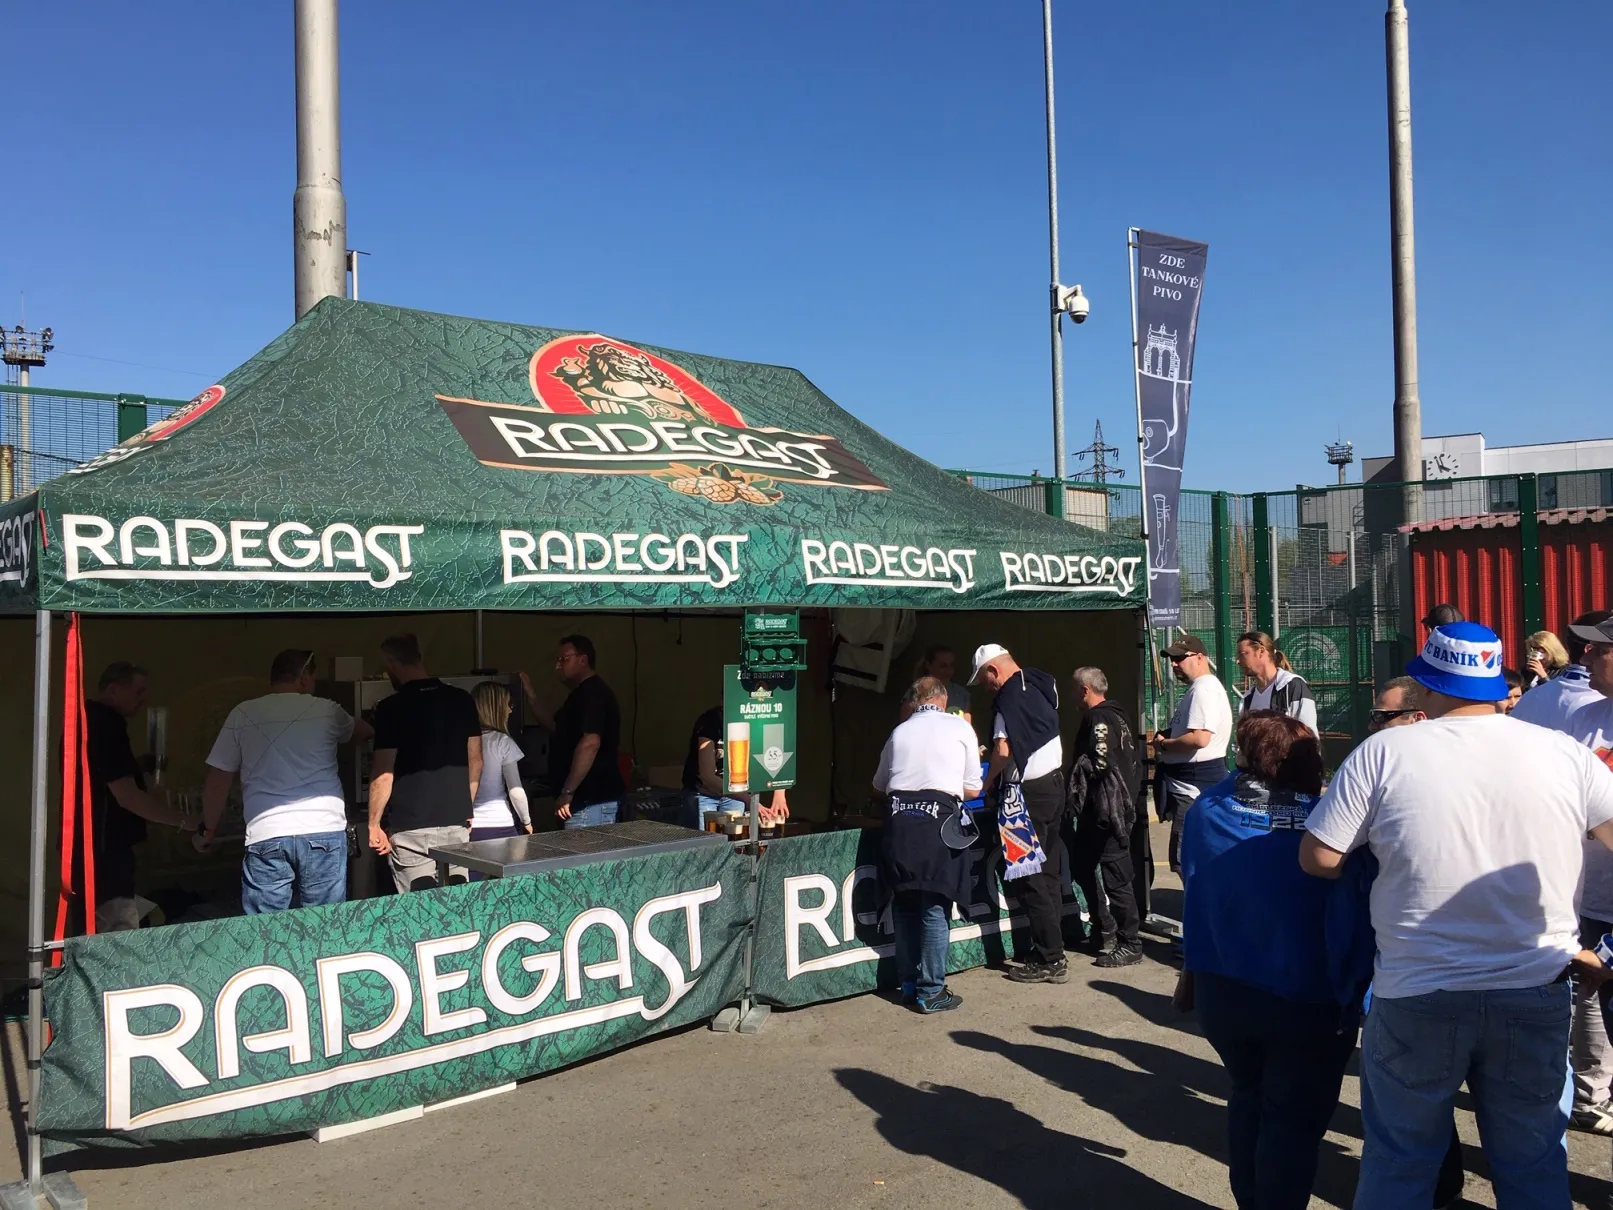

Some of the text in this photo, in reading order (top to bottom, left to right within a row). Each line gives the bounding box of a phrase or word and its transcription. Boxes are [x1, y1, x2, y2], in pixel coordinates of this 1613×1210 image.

[1141, 266, 1200, 290] TANKOVÉ
[1158, 253, 1186, 269] ZDE
[1152, 285, 1182, 301] PIVO
[487, 415, 840, 480] RADEGAST
[62, 513, 425, 589] RADEGAST
[499, 529, 749, 589] RADEGAST
[800, 538, 978, 594] RADEGAST
[999, 551, 1142, 598] RADEGAST
[1432, 645, 1480, 667] BANÍK
[739, 702, 783, 714] RÁZNOU 10
[103, 880, 722, 1131] RADEGAST
